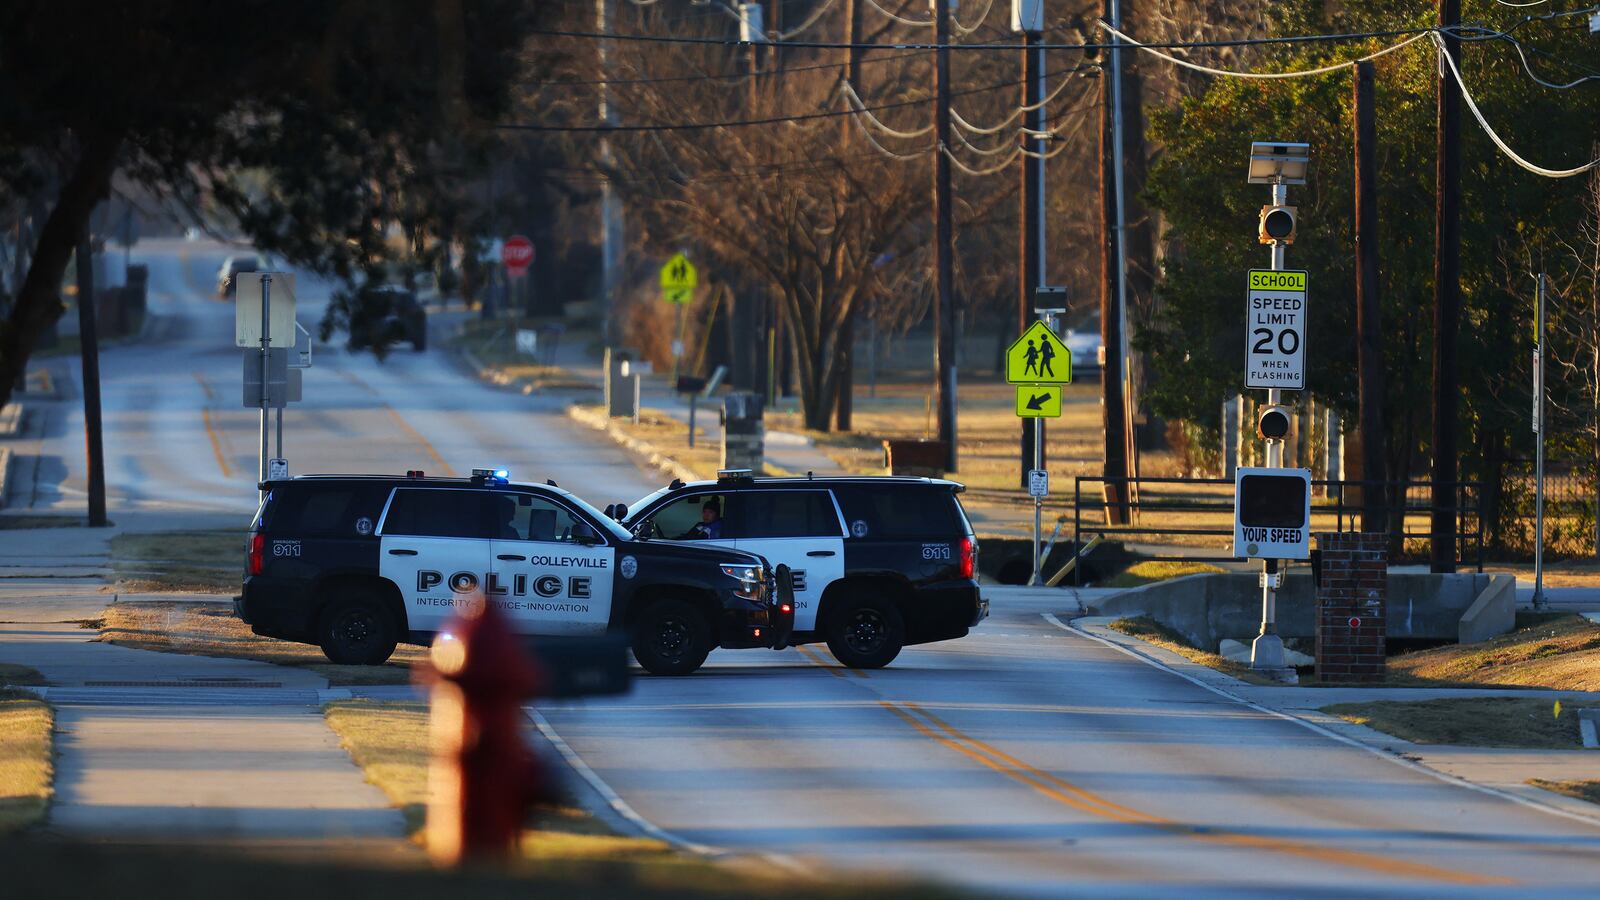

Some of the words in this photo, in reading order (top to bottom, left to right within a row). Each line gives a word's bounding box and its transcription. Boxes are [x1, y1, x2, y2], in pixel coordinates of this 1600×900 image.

[1252, 275, 1303, 287] SCHOOL
[1253, 298, 1301, 310] SPEED
[1257, 313, 1296, 325] LIMIT
[1252, 328, 1299, 355] 20
[1251, 371, 1300, 380] FLASHING
[1242, 528, 1268, 542] YOUR
[1270, 529, 1302, 543] SPEED
[273, 544, 301, 556] 911
[922, 547, 950, 559] 911
[531, 555, 607, 568] COLLEYVILLE
[416, 570, 592, 599] POLICE
